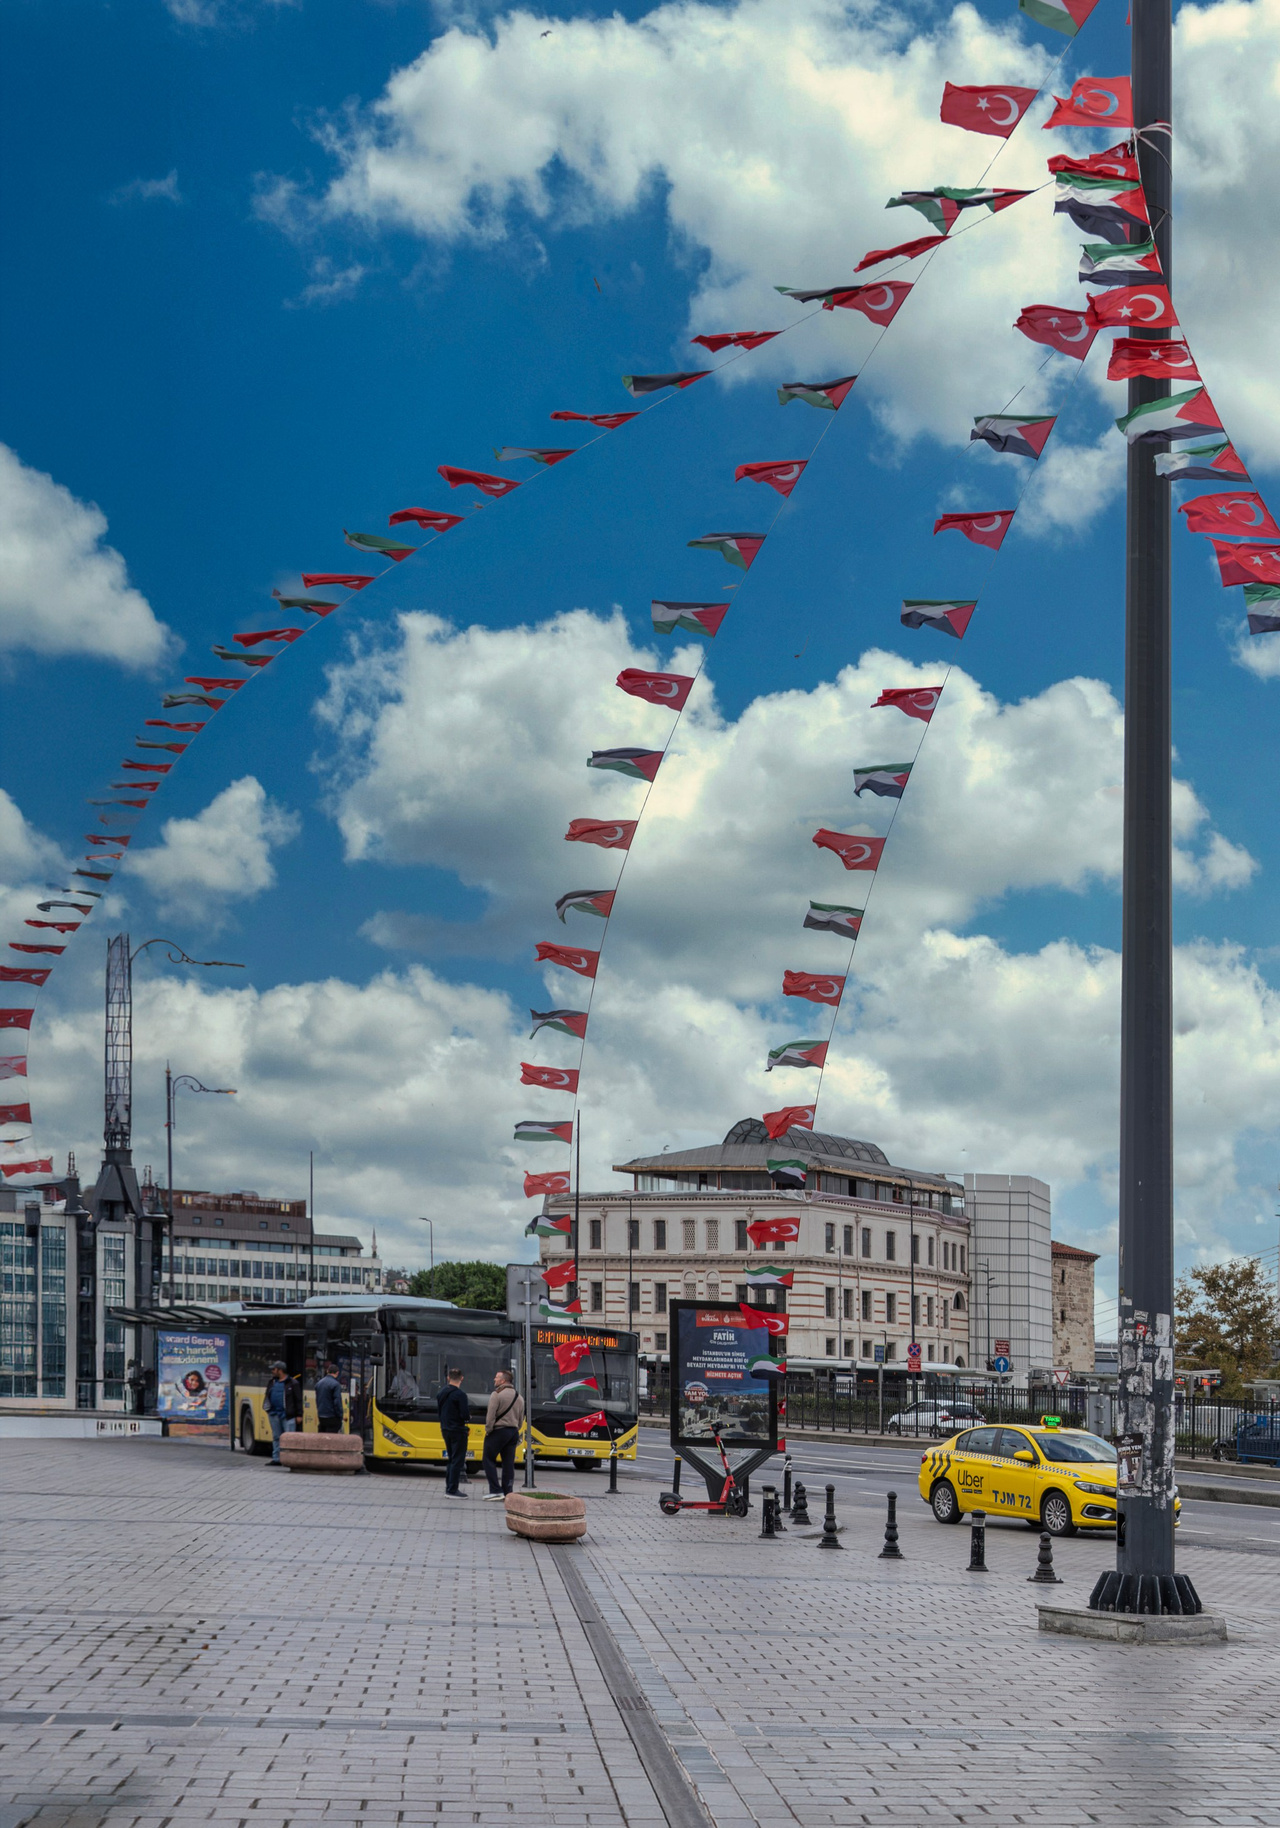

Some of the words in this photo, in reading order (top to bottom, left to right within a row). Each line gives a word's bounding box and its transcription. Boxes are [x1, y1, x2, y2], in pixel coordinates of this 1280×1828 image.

[191, 1336, 213, 1346] Genç
[214, 1337, 225, 1346] ile
[713, 1331, 735, 1341] FATİH
[186, 1355, 218, 1364] dönemi
[957, 1470, 984, 1488] Uber
[992, 1490, 1016, 1506] TJM
[1018, 1494, 1032, 1509] 72
